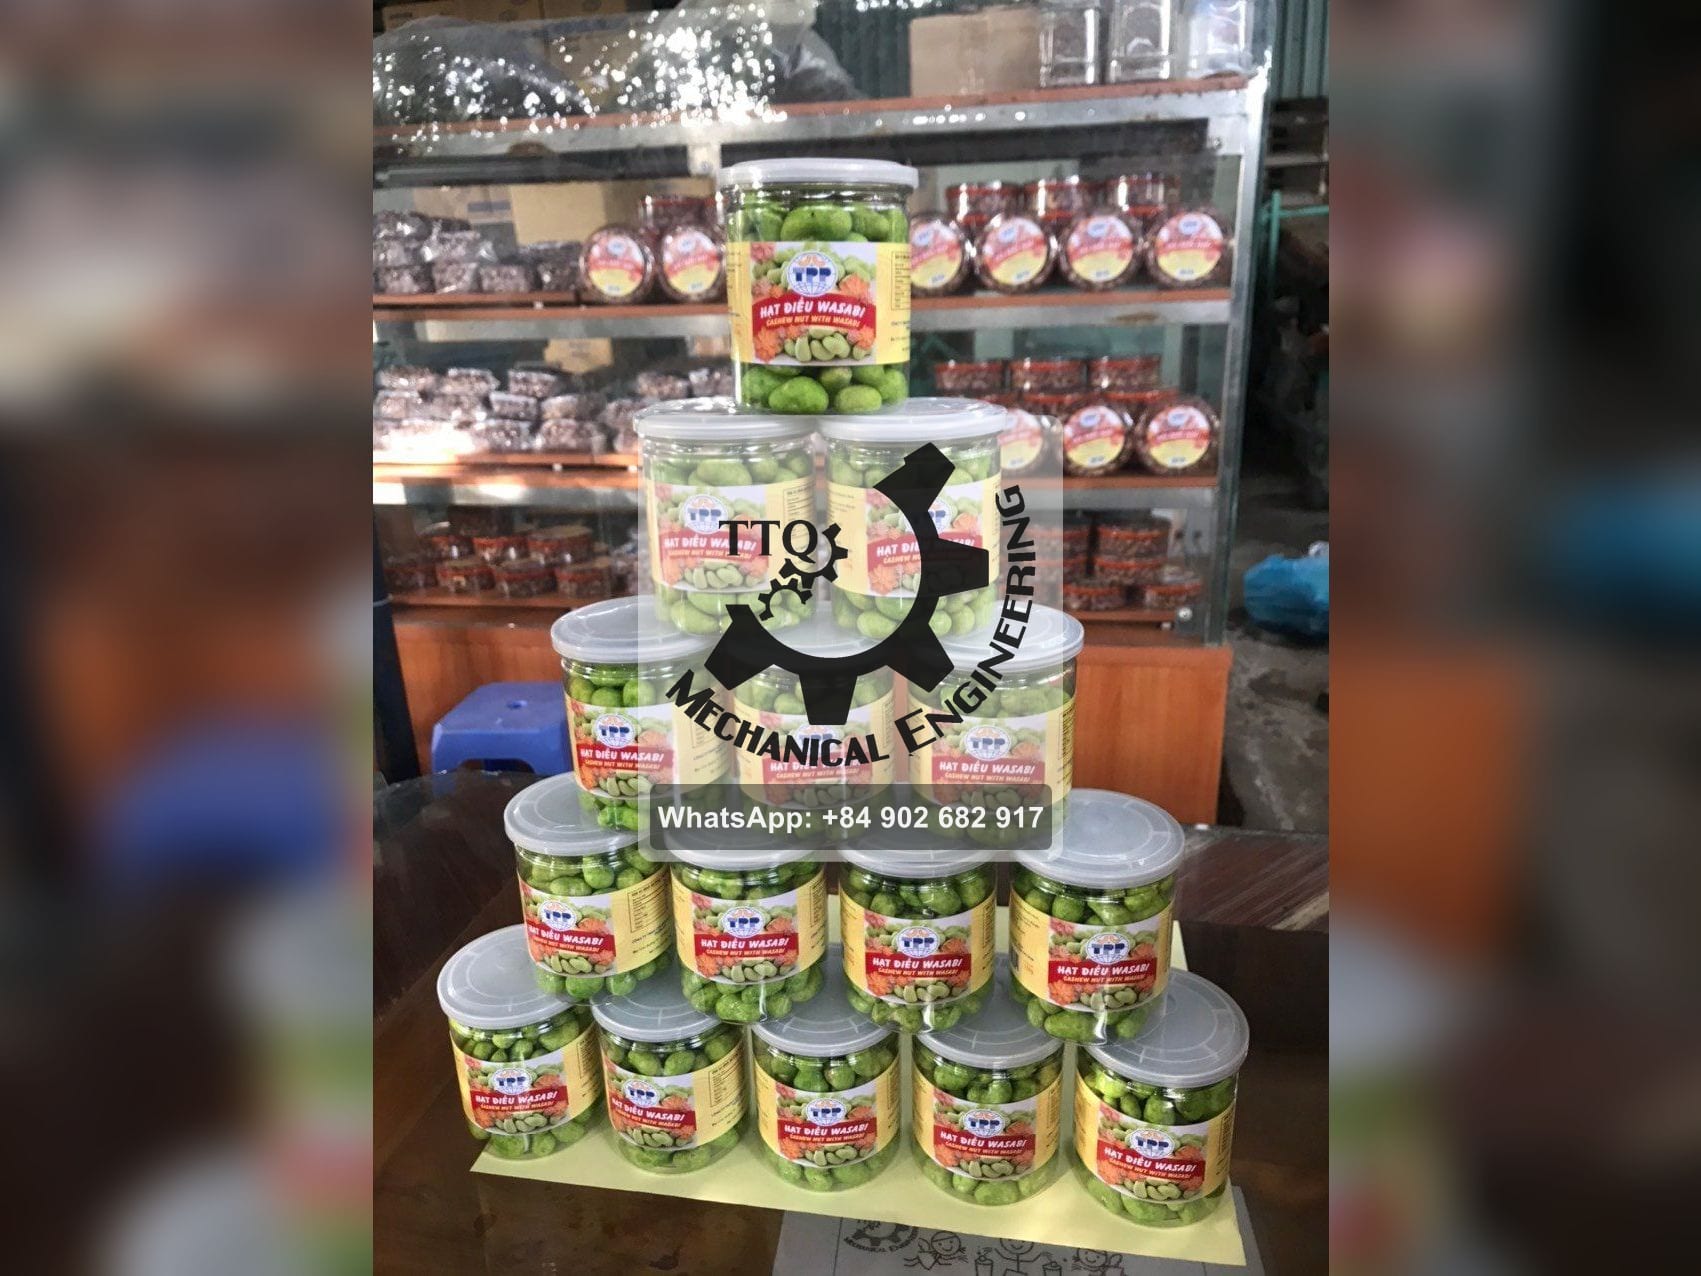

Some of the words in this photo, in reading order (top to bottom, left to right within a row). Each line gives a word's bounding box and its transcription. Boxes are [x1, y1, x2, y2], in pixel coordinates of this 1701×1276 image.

[793, 268, 831, 283] TPP
[818, 301, 866, 317] WASABI
[688, 508, 721, 521] TPP
[599, 726, 629, 737] TPP
[970, 737, 1005, 749] TPP
[621, 752, 664, 762] WASABI
[992, 764, 1035, 774] WASABI
[545, 910, 571, 919] TPP
[728, 917, 759, 928] TPP
[563, 935, 604, 945] WASABI
[749, 938, 789, 948] WASABI
[902, 938, 934, 947] TPP
[1092, 943, 1124, 954] TPP
[923, 959, 962, 968] WASABI
[1112, 963, 1150, 974] WASABI
[497, 1077, 525, 1086] TPP
[628, 1086, 655, 1097] TPP
[518, 1091, 558, 1103] WASABI
[646, 1111, 685, 1121] WASABI
[811, 1108, 841, 1117] TPP
[968, 1118, 1000, 1128] TPP
[831, 1123, 869, 1134] WASABI
[988, 1139, 1027, 1148] WASABI
[1136, 1136, 1169, 1150] TPP
[1155, 1162, 1196, 1172] WASABI
